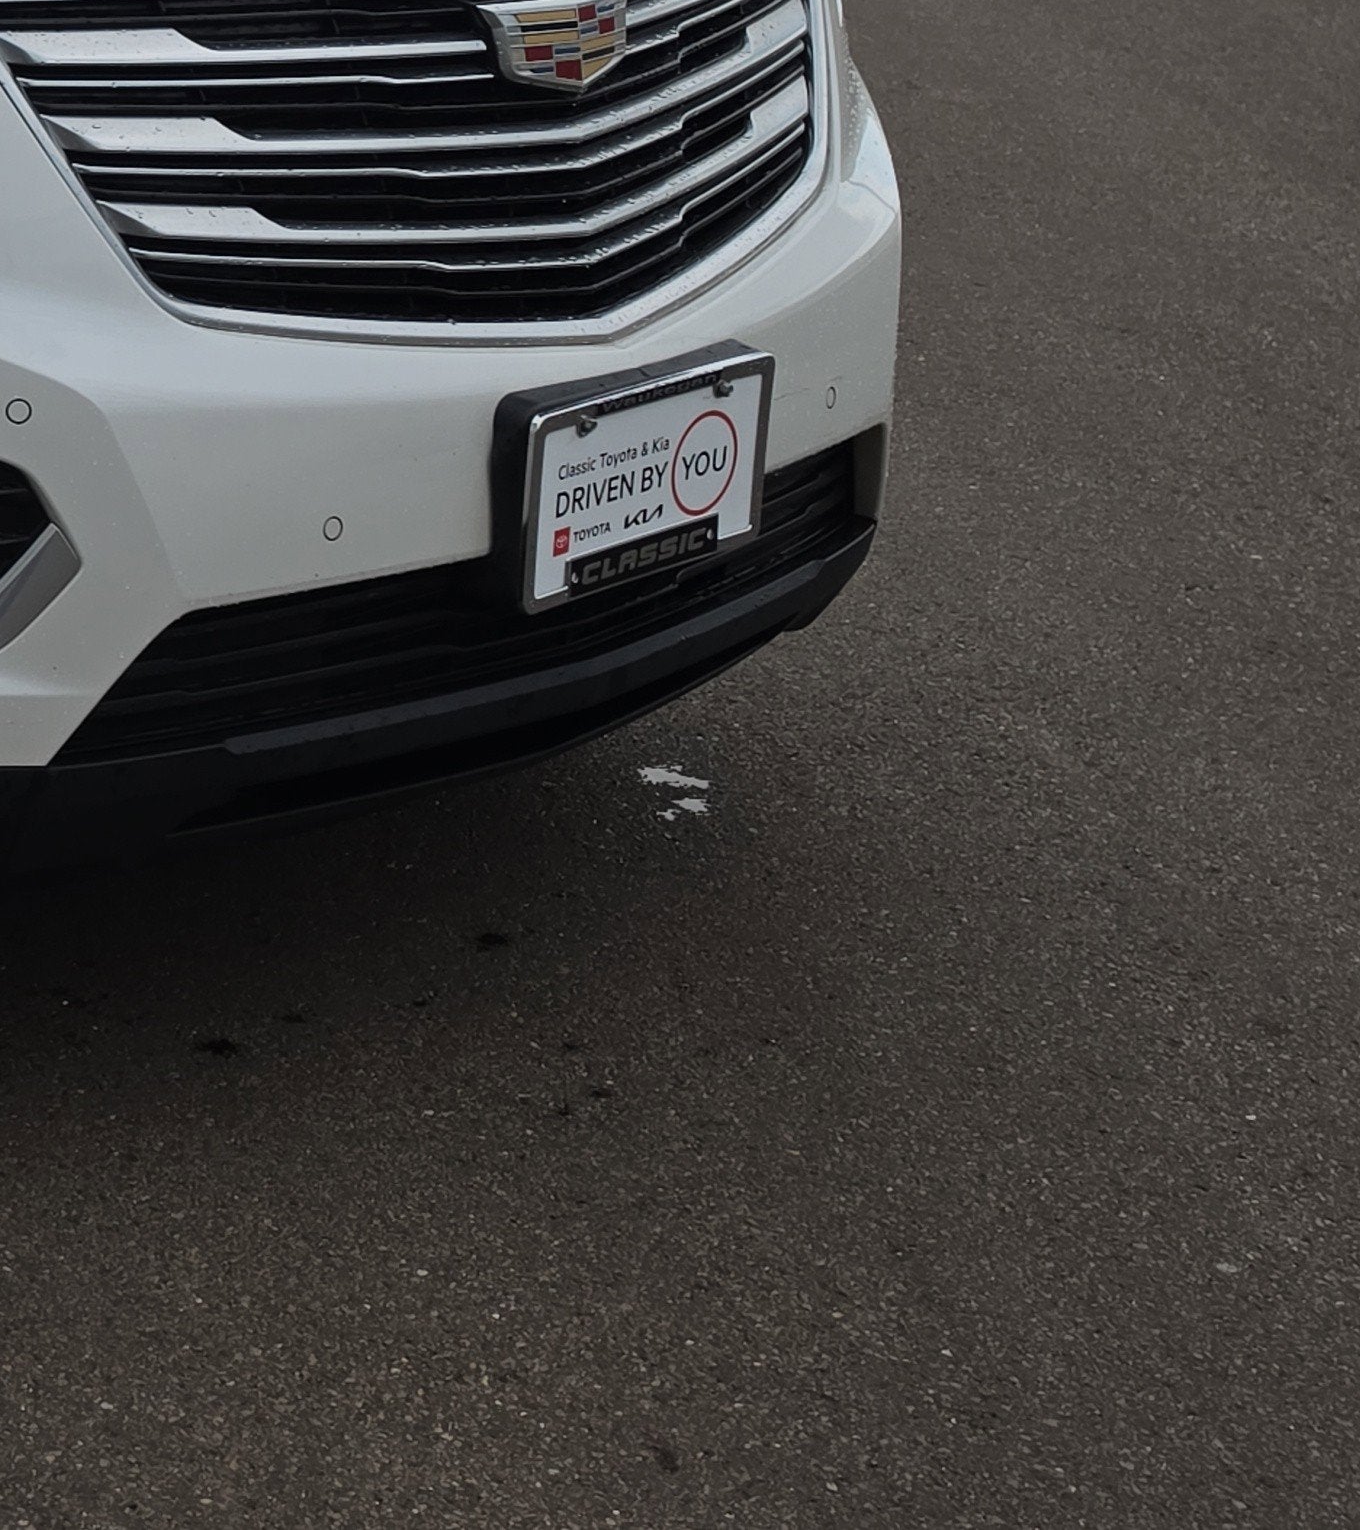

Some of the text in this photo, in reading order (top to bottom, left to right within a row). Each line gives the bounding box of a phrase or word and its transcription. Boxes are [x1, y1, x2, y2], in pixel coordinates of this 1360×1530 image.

[601, 373, 718, 414] Waukegan
[558, 436, 670, 480] Classic Toyota & Kia
[555, 445, 728, 519] DRIVEN BY YOU
[573, 522, 612, 543] TOYOTA
[581, 527, 707, 586] CLASSIC
